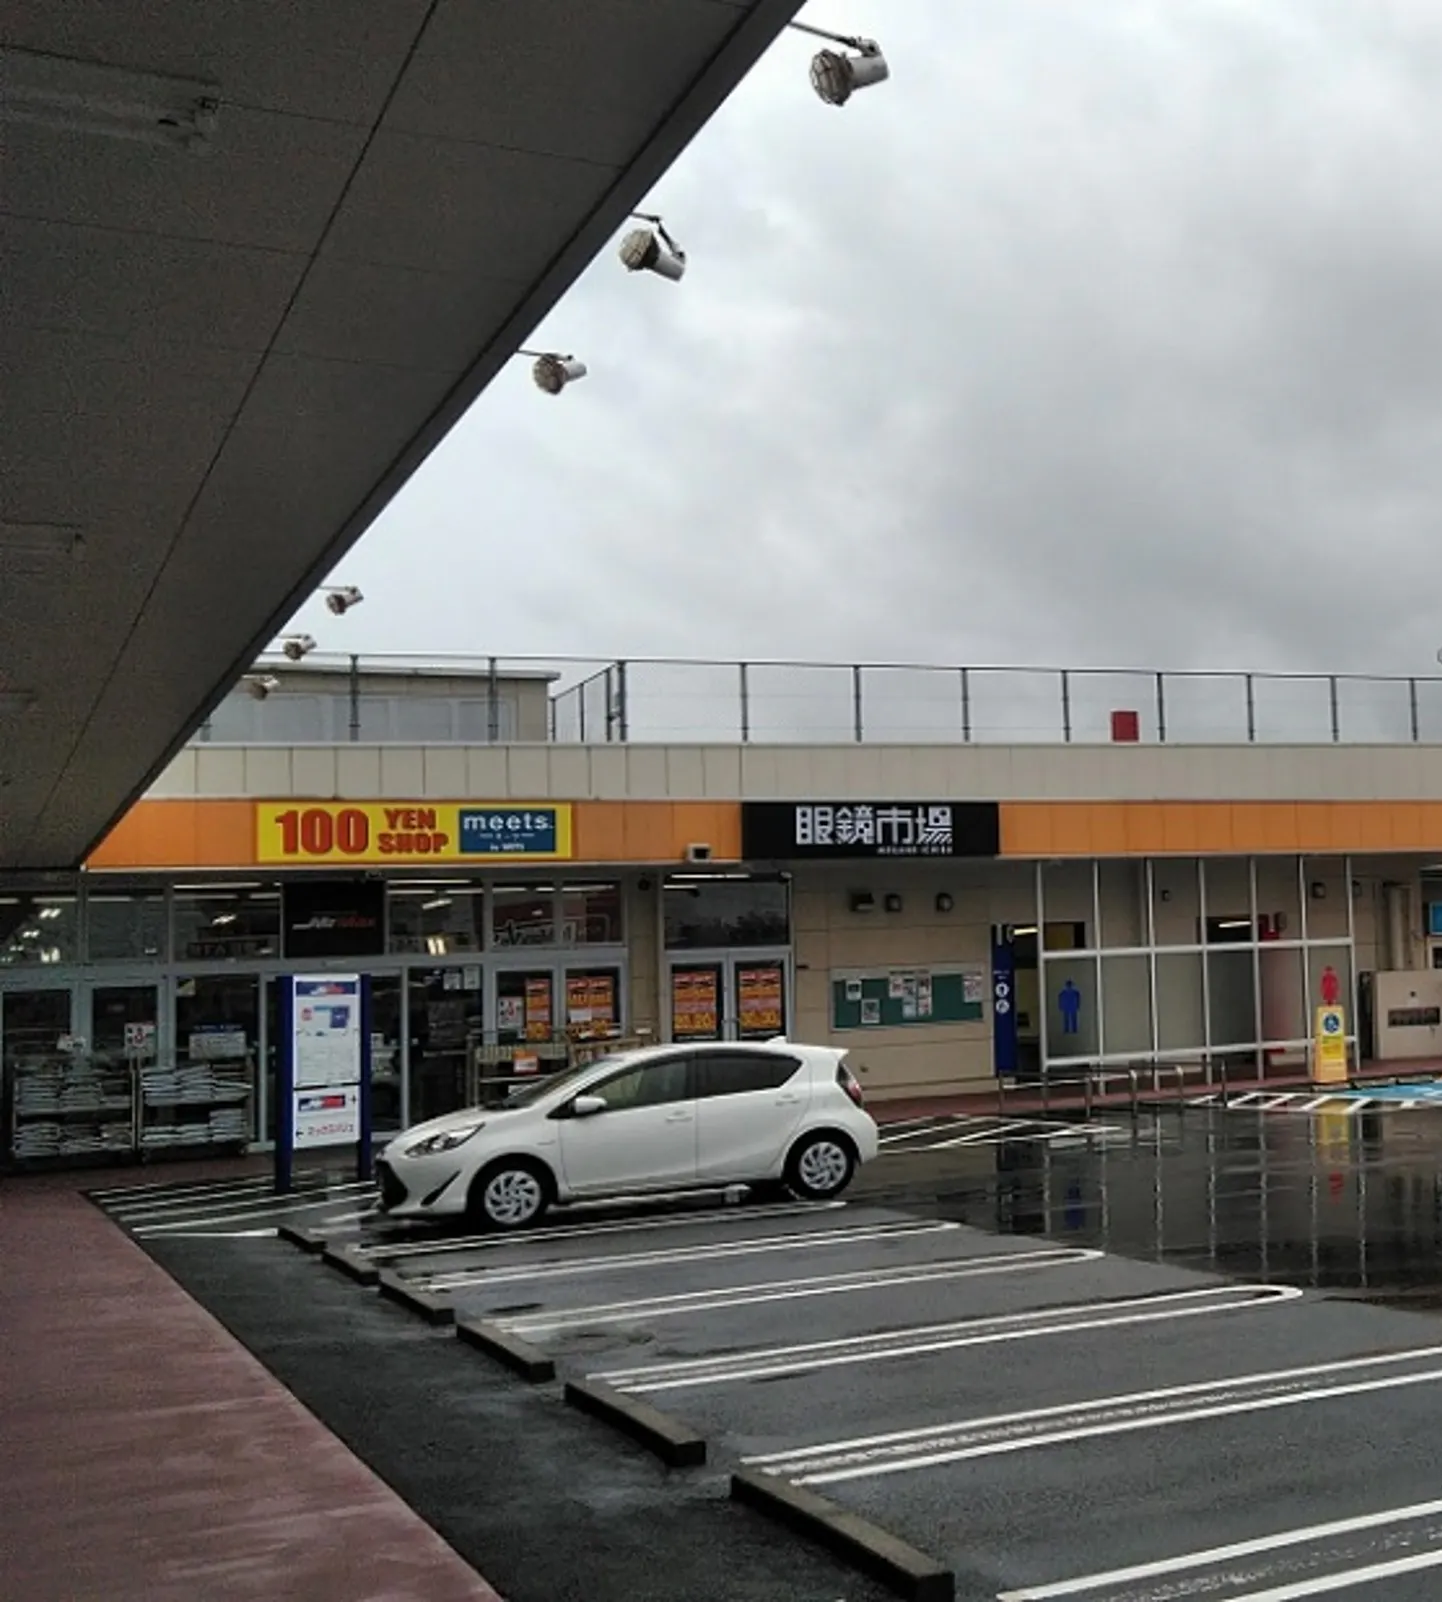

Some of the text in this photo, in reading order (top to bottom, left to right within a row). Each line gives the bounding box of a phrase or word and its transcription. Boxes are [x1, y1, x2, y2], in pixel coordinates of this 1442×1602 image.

[275, 808, 369, 855] 100
[383, 808, 437, 830] YEN
[796, 805, 953, 845] 眼鏡市場
[378, 833, 449, 855] SHOP
